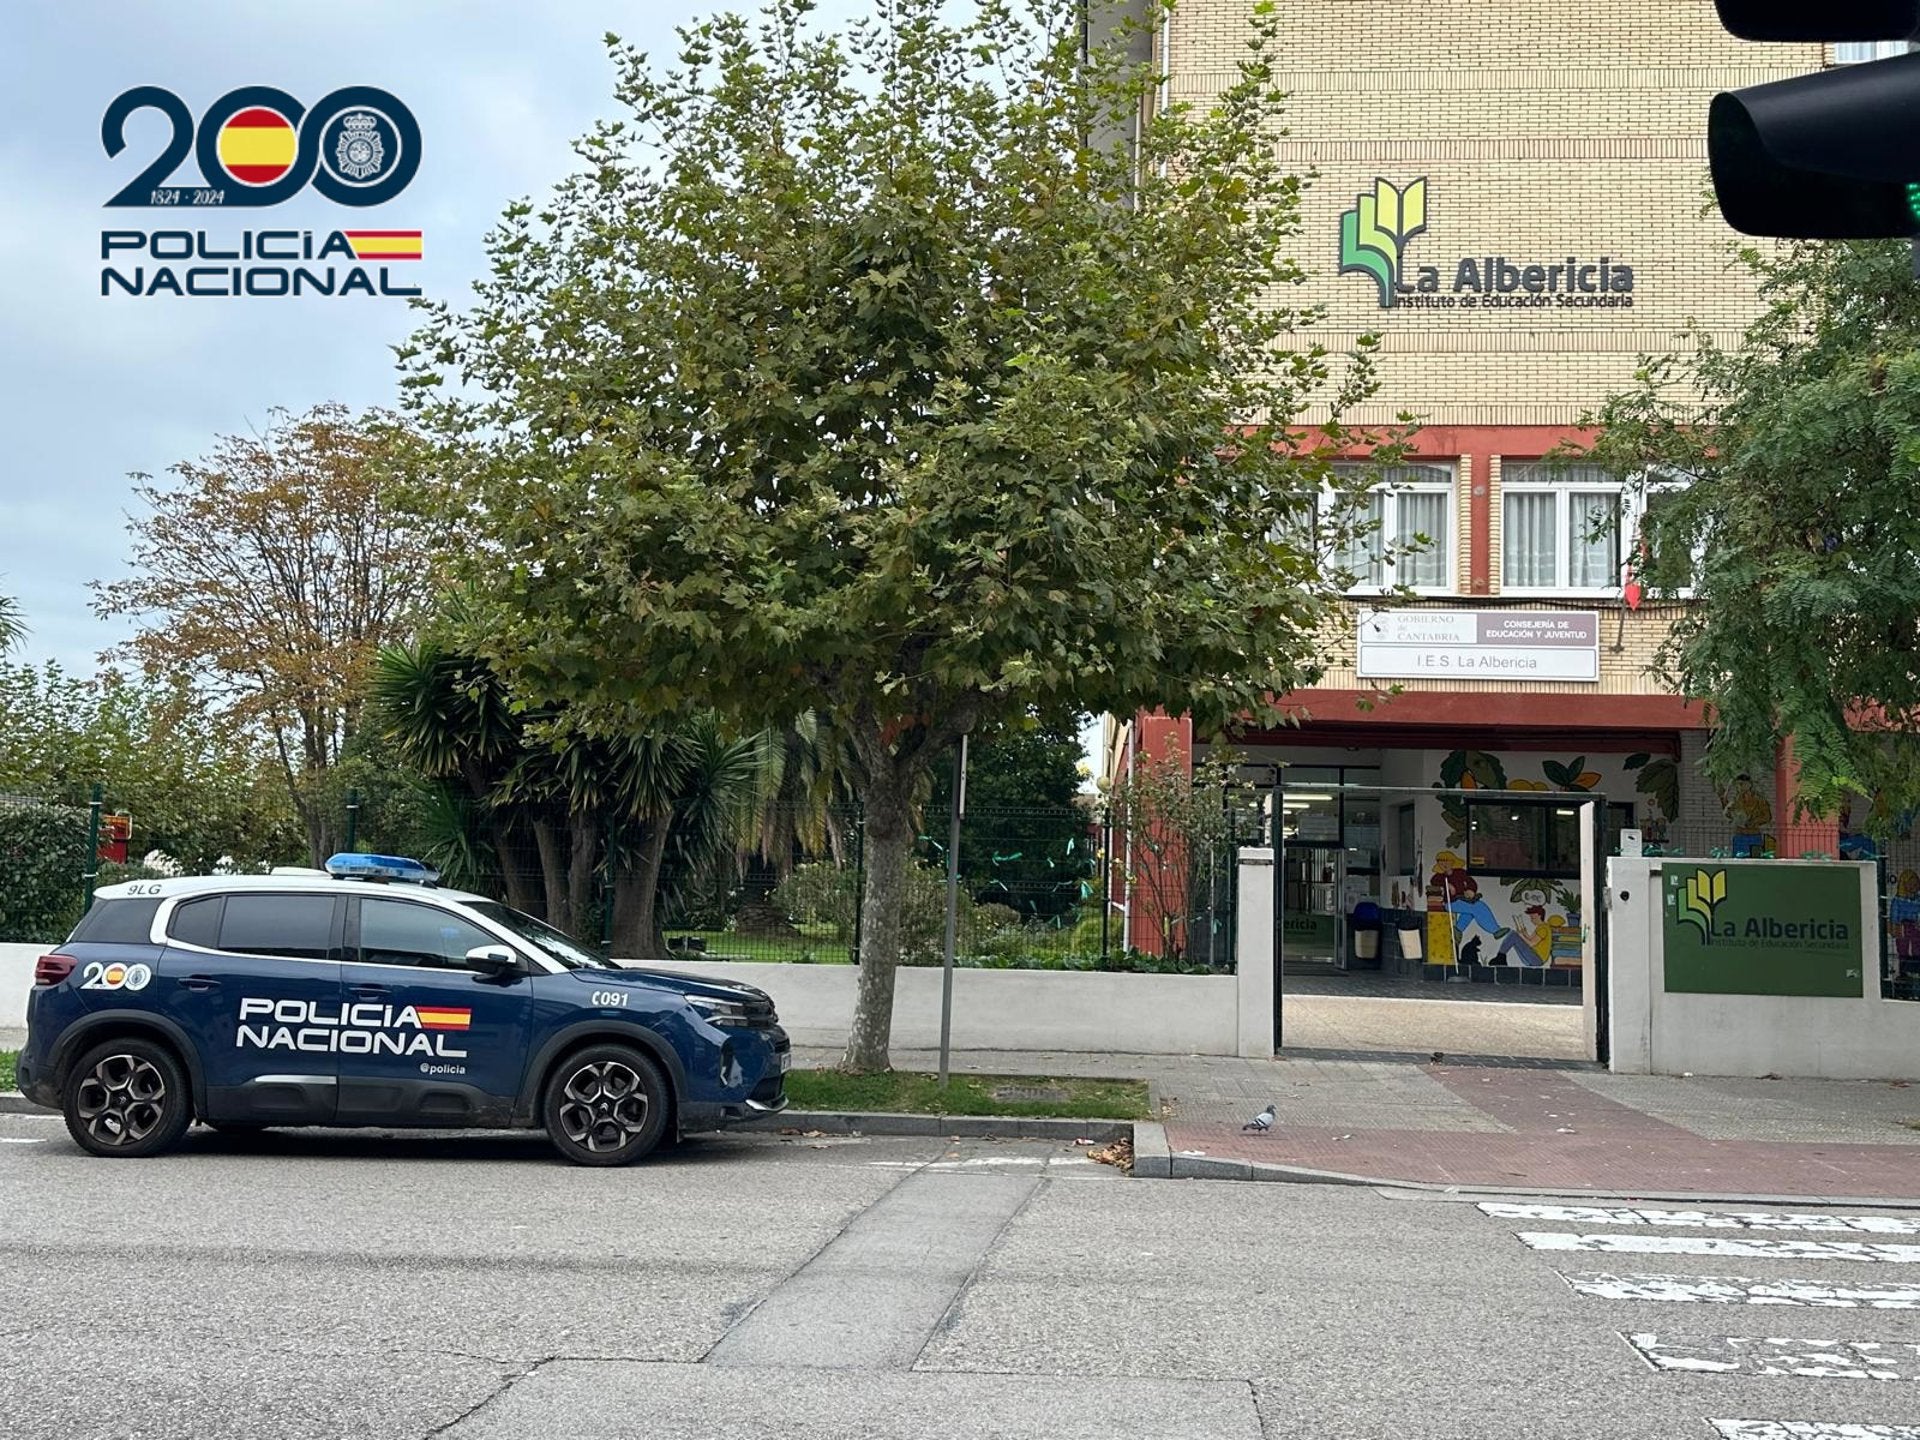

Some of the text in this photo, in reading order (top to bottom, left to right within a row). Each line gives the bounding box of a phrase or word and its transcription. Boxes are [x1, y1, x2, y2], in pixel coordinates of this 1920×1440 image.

[1396, 257, 1634, 293] La Albericia
[1395, 294, 1633, 308] Instituto de Educación Secundaria
[1397, 615, 1455, 624] GOBIERNO
[1503, 620, 1570, 629] CONSEJERÍA DE
[1397, 632, 1460, 642] CANTABRIA
[1486, 630, 1533, 639] EDUCACIÓN
[1544, 631, 1587, 639] JUVENTUD
[1458, 656, 1475, 668] La
[1479, 656, 1537, 669] Albericia
[127, 884, 162, 895] 9LG
[1710, 917, 1848, 940] La Albericia
[80, 961, 152, 991] 200
[236, 1024, 468, 1058] NACIONAL
